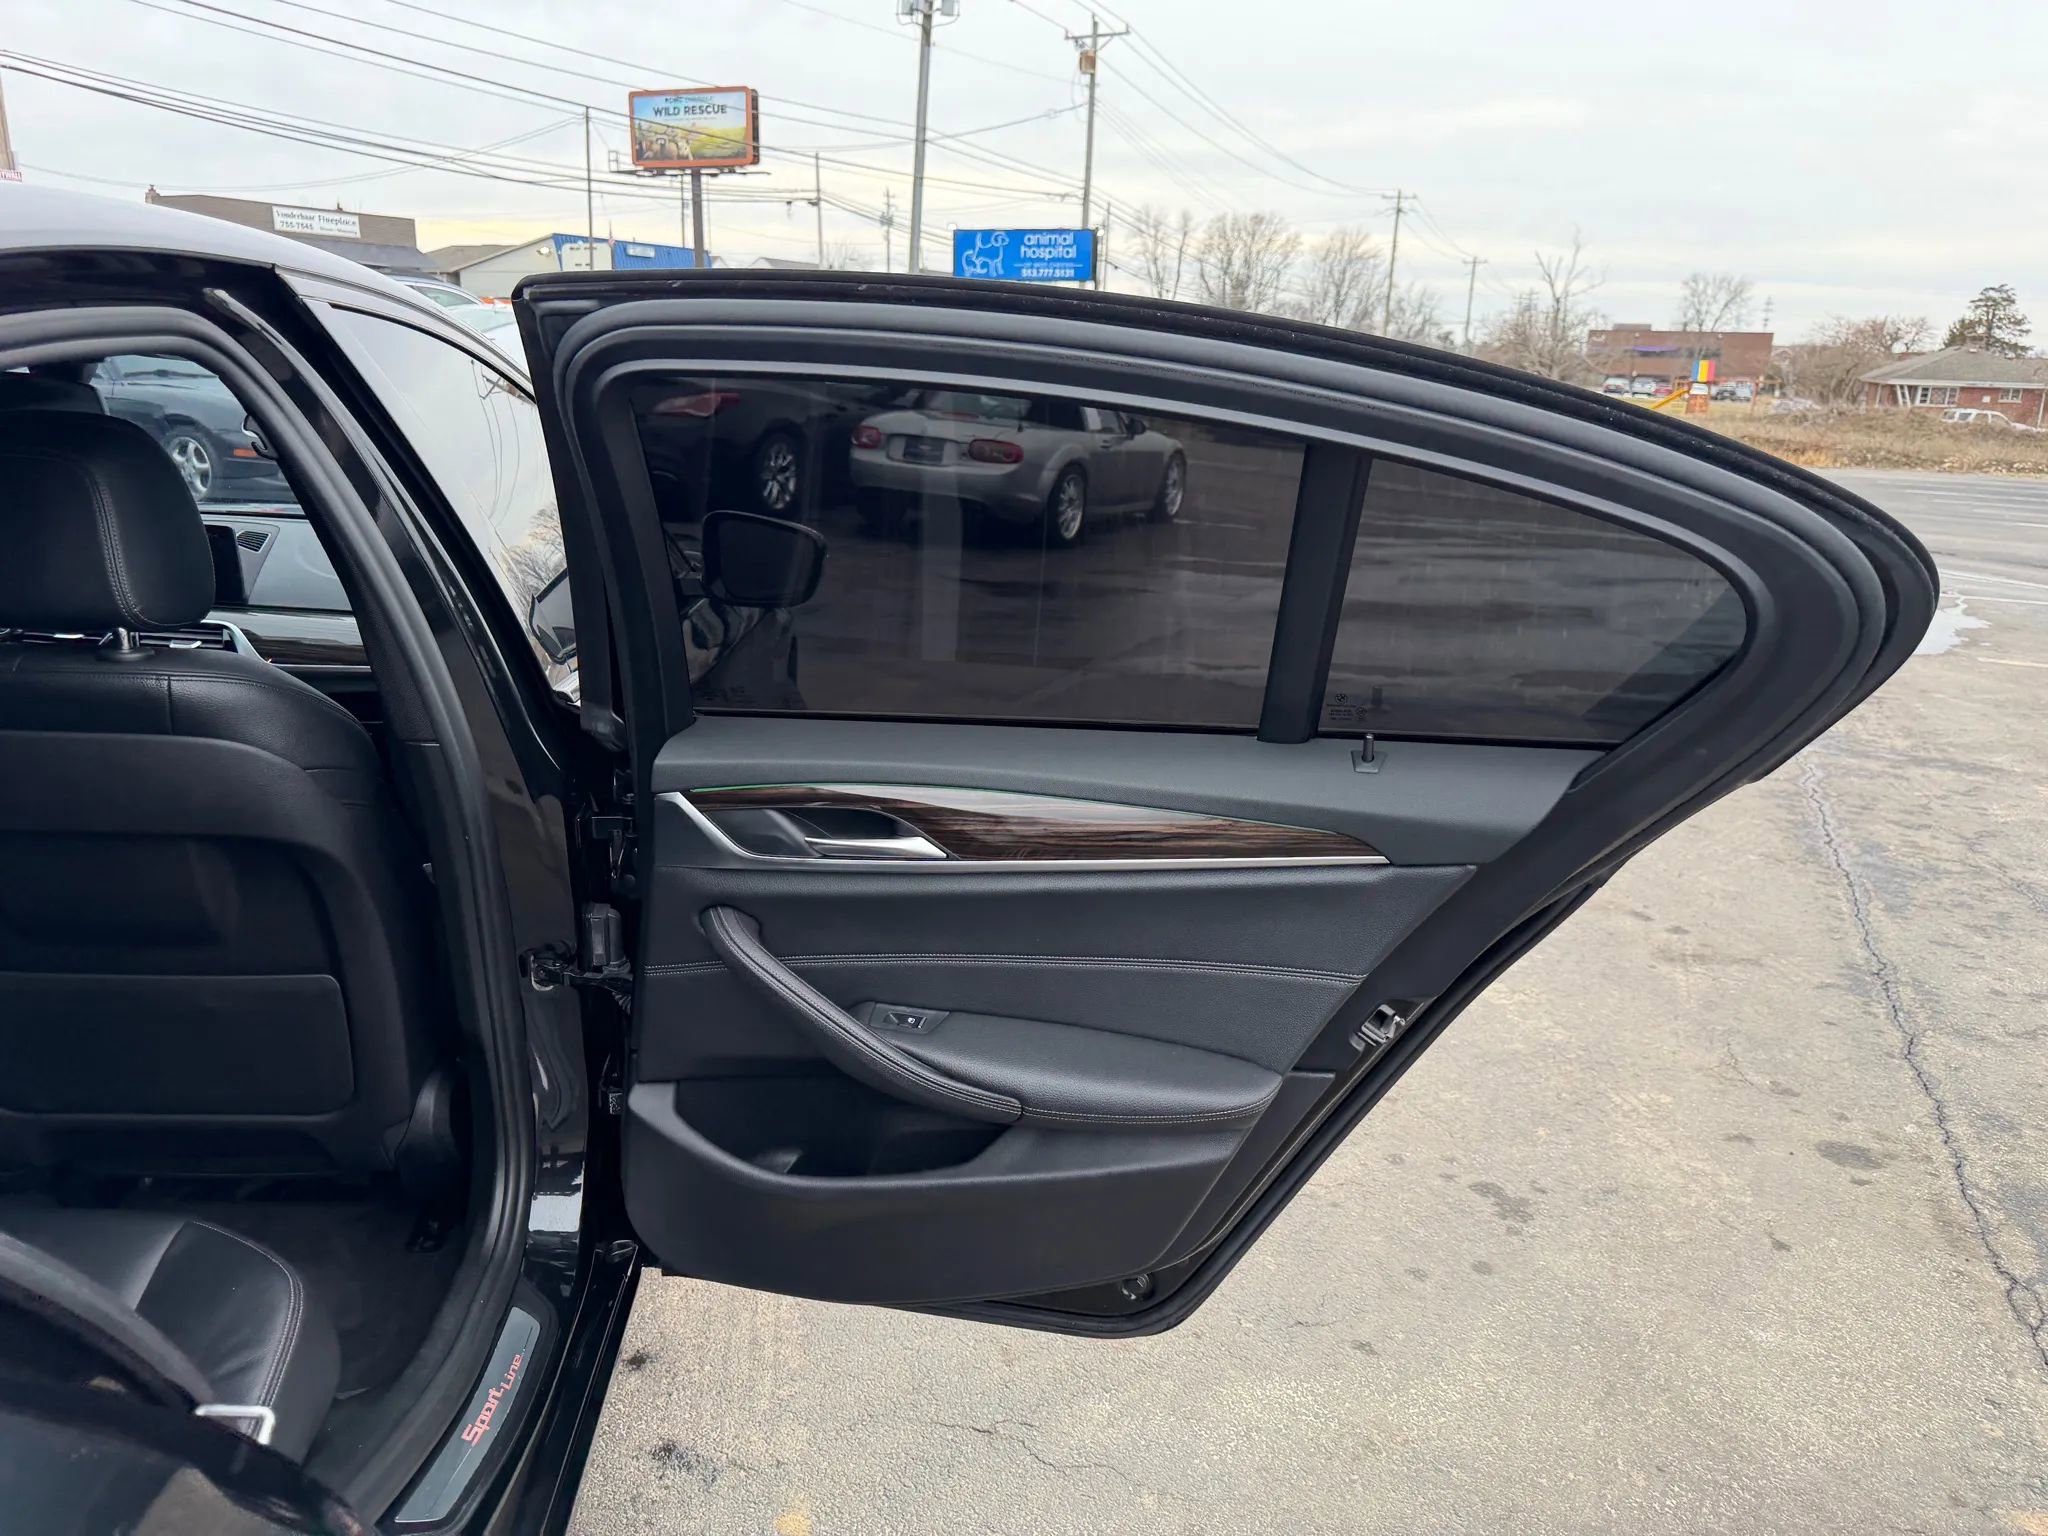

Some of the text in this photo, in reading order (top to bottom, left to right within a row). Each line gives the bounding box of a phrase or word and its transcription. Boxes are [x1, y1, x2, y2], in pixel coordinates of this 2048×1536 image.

[652, 104, 728, 118] WILD RESCUE
[318, 214, 357, 226] Fireplace
[1023, 231, 1075, 246] animal
[1020, 244, 1078, 261] hospital
[460, 1353, 523, 1448] Sport Line
